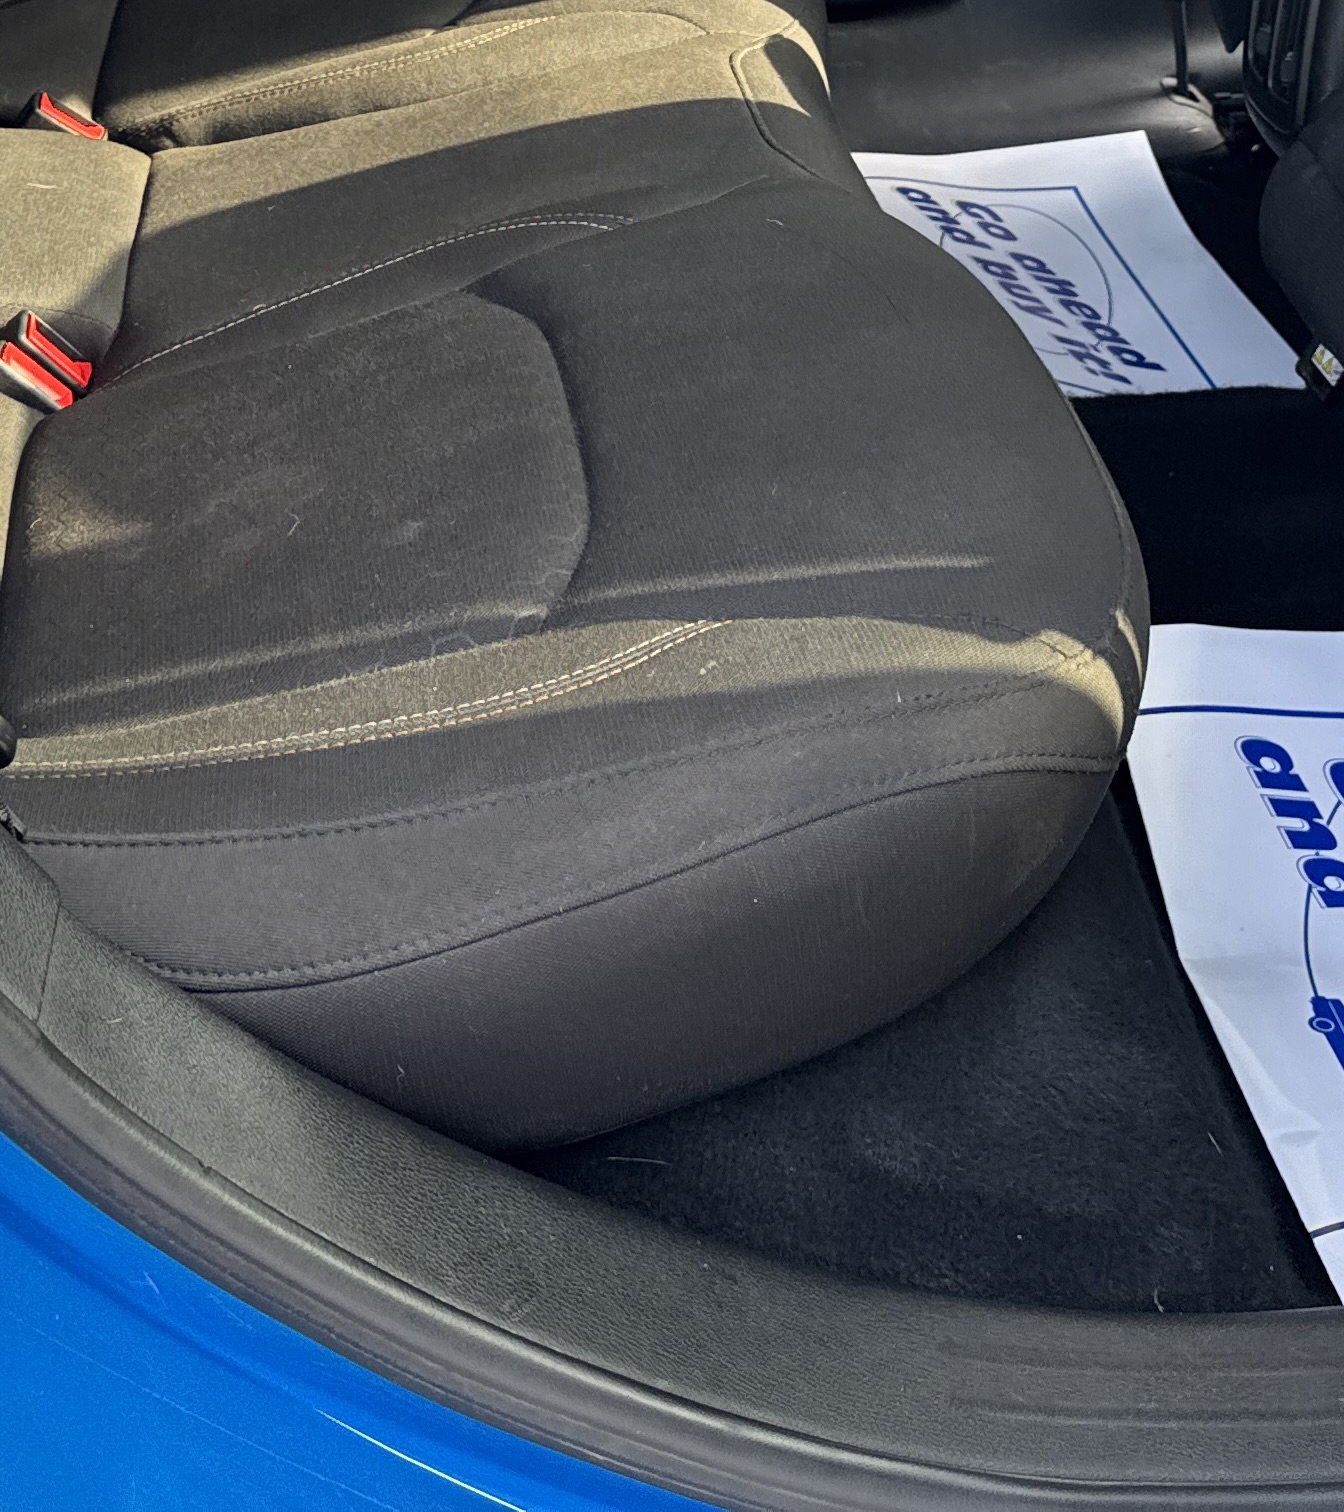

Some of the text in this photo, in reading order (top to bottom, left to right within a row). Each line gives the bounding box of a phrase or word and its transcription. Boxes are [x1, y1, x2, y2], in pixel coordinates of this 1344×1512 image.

[894, 186, 1133, 385] and buy it!
[953, 199, 1166, 372] Go ahead
